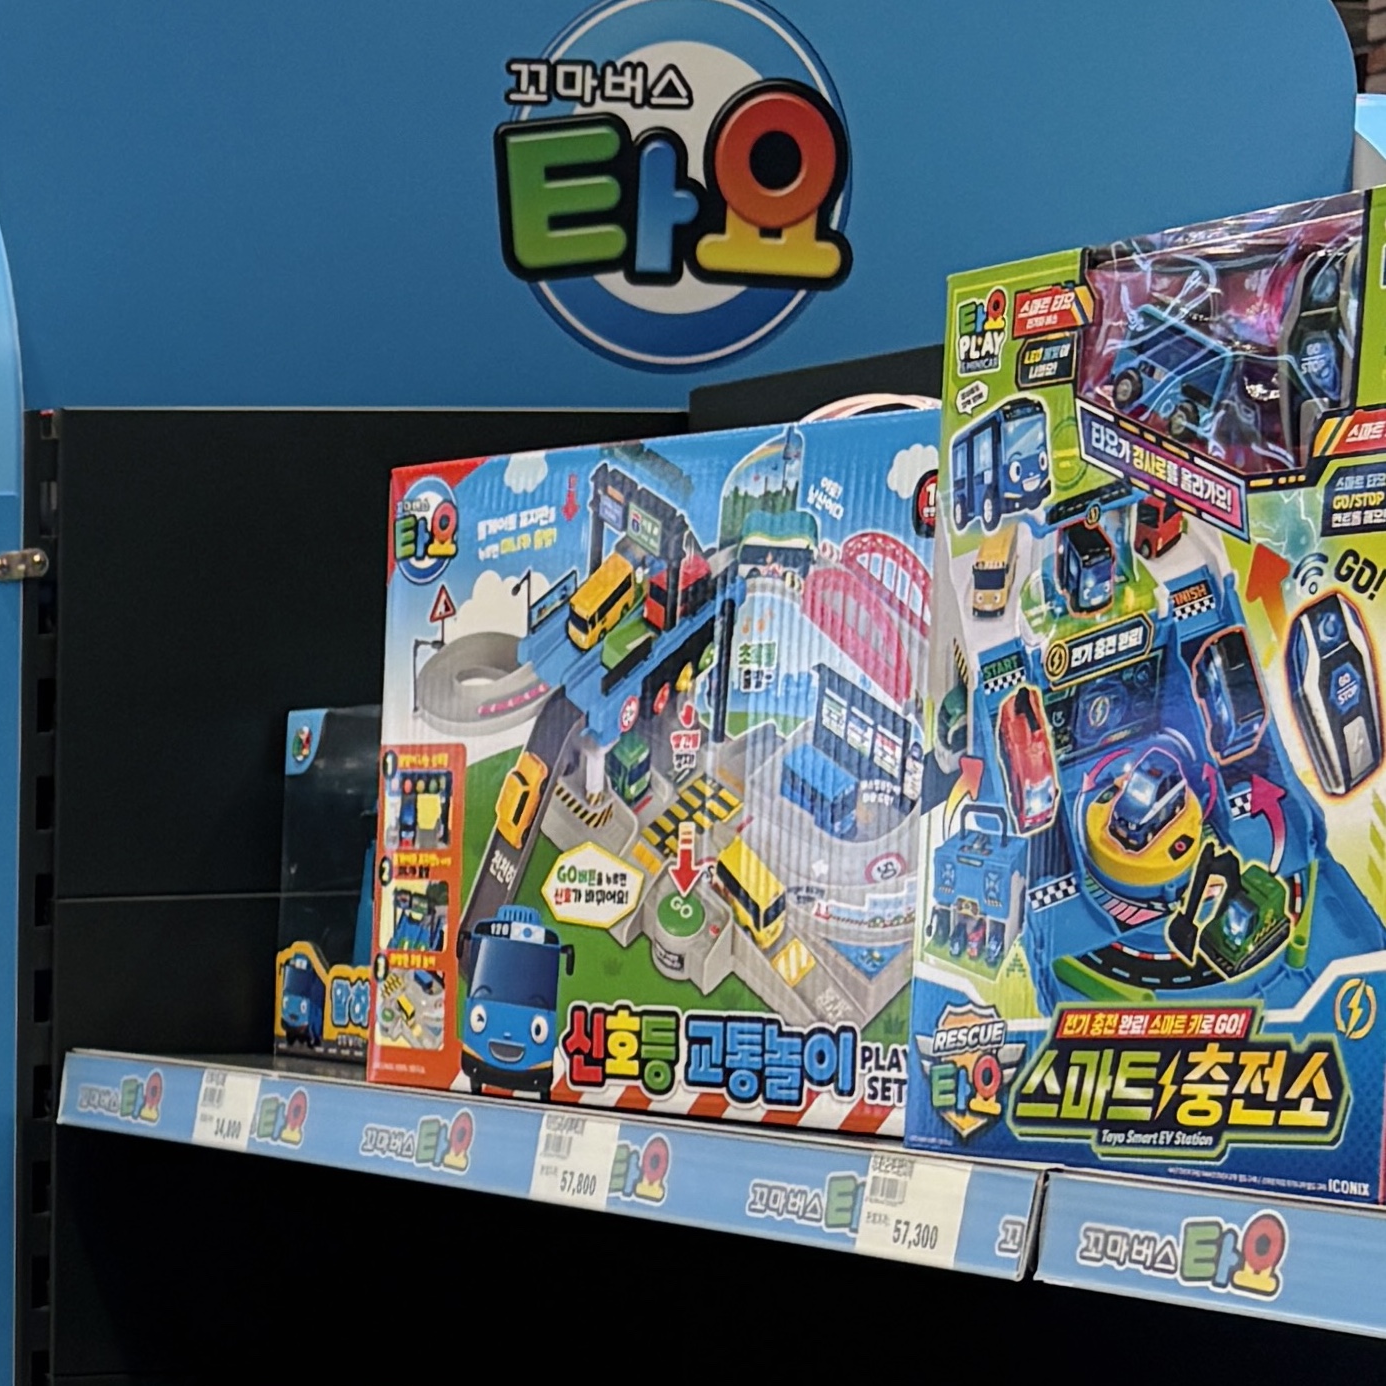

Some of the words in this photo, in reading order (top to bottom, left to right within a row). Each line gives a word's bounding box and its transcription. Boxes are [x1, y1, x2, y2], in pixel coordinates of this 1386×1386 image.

[506, 57, 694, 110] 꼬마버스
[495, 78, 852, 287] 타요
[958, 288, 1008, 335] 타요
[959, 330, 1006, 361] PLAY
[1089, 423, 1131, 464] 타요가
[1178, 469, 1233, 514] 올라가요!
[1331, 490, 1386, 510] GO/STOP
[394, 501, 459, 560] 타요
[1333, 547, 1386, 602] GO!
[669, 897, 694, 918] GO
[932, 1021, 1006, 1052] RESCUE
[1062, 1015, 1088, 1038] 전기
[1088, 1015, 1116, 1037] 충전
[1117, 1014, 1148, 1036] 완료!
[1149, 1013, 1188, 1036] 스마트
[1187, 1013, 1214, 1036] 키로
[1214, 1013, 1246, 1036] GO!
[565, 1003, 684, 1081] 신호등
[685, 1006, 854, 1107] 교통놀이
[118, 1067, 164, 1124] 타요
[931, 1055, 1003, 1118] 타요
[1016, 1047, 1159, 1121] 스마트
[1175, 1042, 1334, 1128] 충전소
[256, 1088, 309, 1146] 타요
[415, 1108, 475, 1174] 타요
[1127, 1129, 1159, 1147] Smart
[1158, 1130, 1174, 1147] EV
[1174, 1130, 1215, 1148] Station
[558, 1168, 598, 1198] 57,800
[610, 1134, 670, 1205] 타요
[1327, 1177, 1371, 1198] ICONIX
[747, 1181, 823, 1220] 꼬마버스
[891, 1218, 940, 1251] 57,300
[1078, 1226, 1179, 1274] 꼬마버스
[1178, 1209, 1291, 1300] 타요
